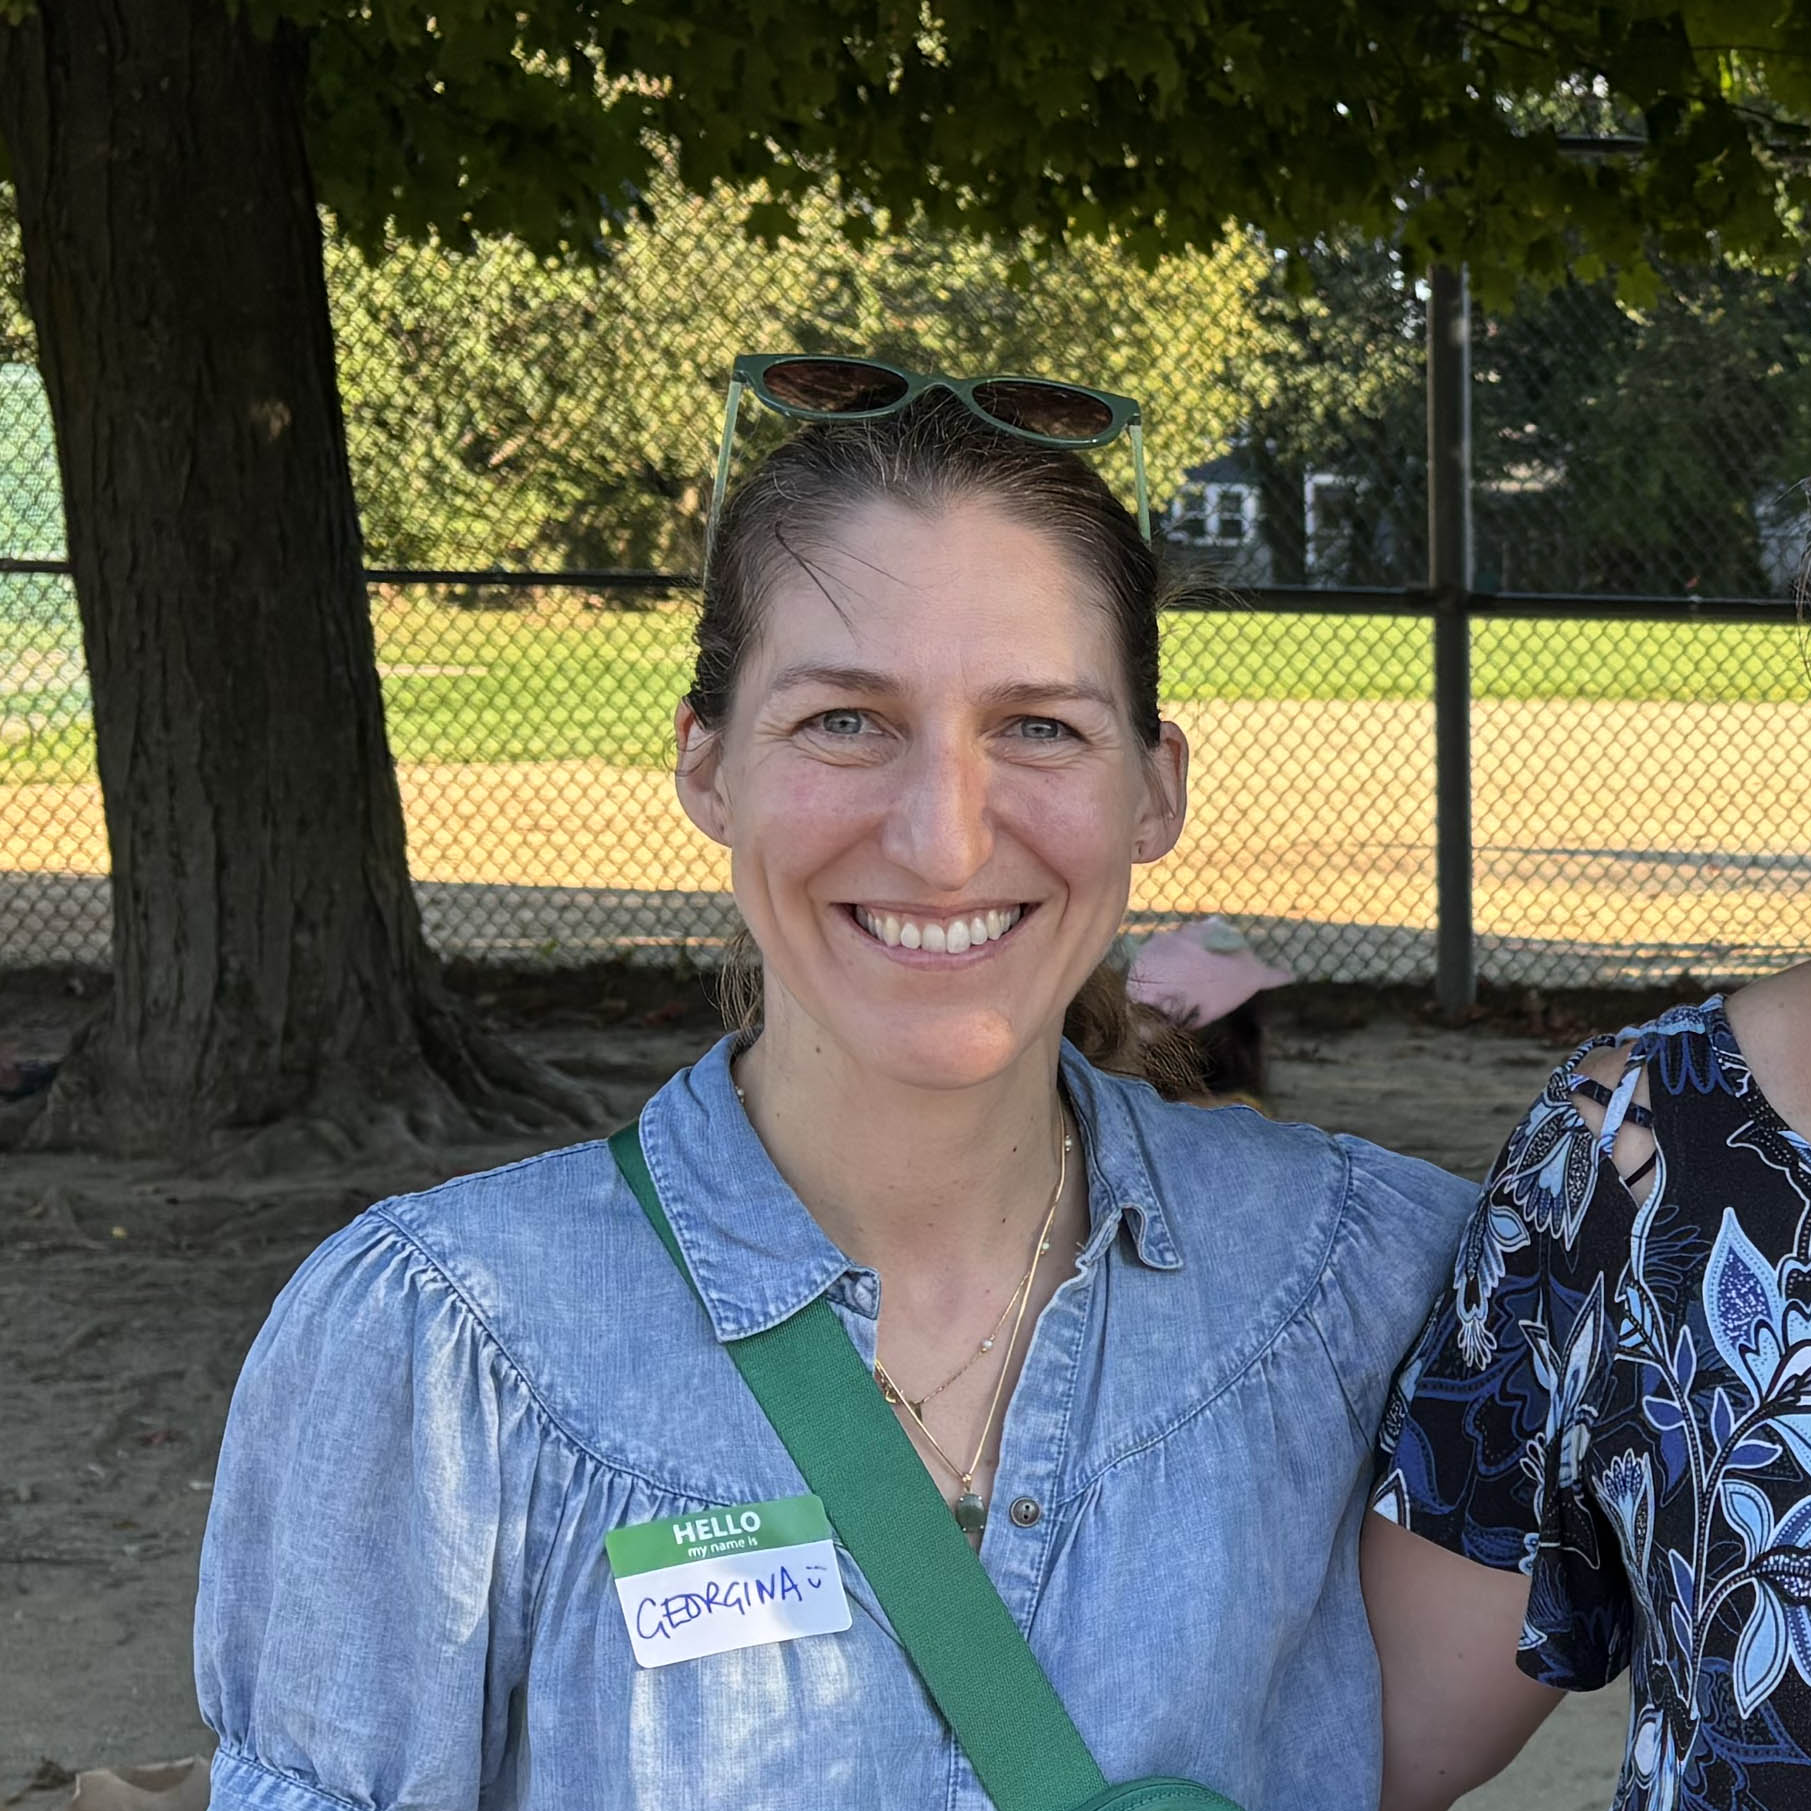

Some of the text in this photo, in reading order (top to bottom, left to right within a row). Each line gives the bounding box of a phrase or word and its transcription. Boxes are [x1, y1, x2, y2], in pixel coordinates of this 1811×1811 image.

[672, 1511, 762, 1545] HELLO
[688, 1536, 758, 1558] my name is
[636, 1565, 803, 1640] GEORGINA
